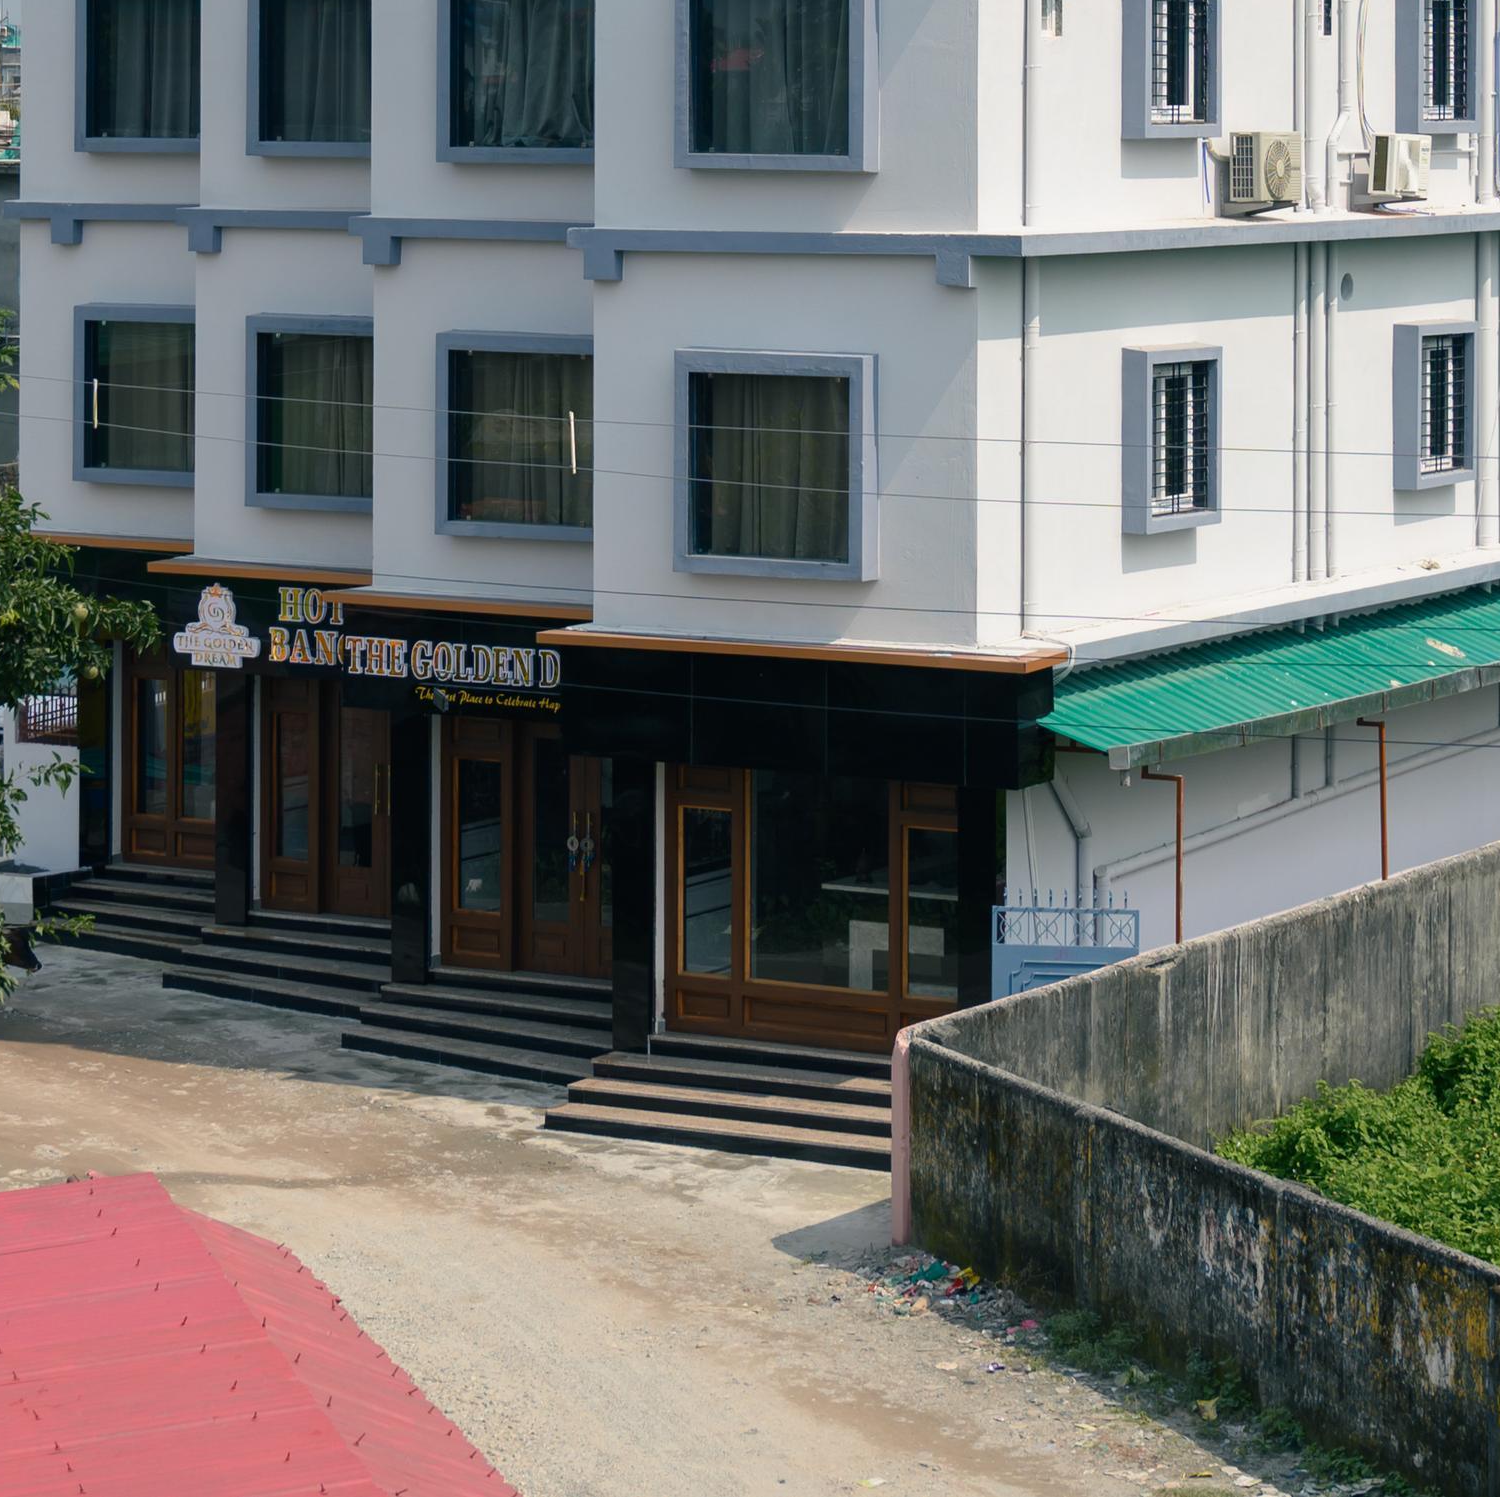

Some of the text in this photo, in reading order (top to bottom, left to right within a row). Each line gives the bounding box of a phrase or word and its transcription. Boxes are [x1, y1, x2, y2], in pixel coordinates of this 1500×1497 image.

[176, 634, 201, 648] THE
[269, 627, 344, 667] BAN
[194, 652, 238, 666] DREAM
[345, 635, 561, 688] THE GOLDEN D
[457, 690, 483, 705] Place
[484, 695, 494, 705] to
[496, 693, 536, 708] Celebrate
